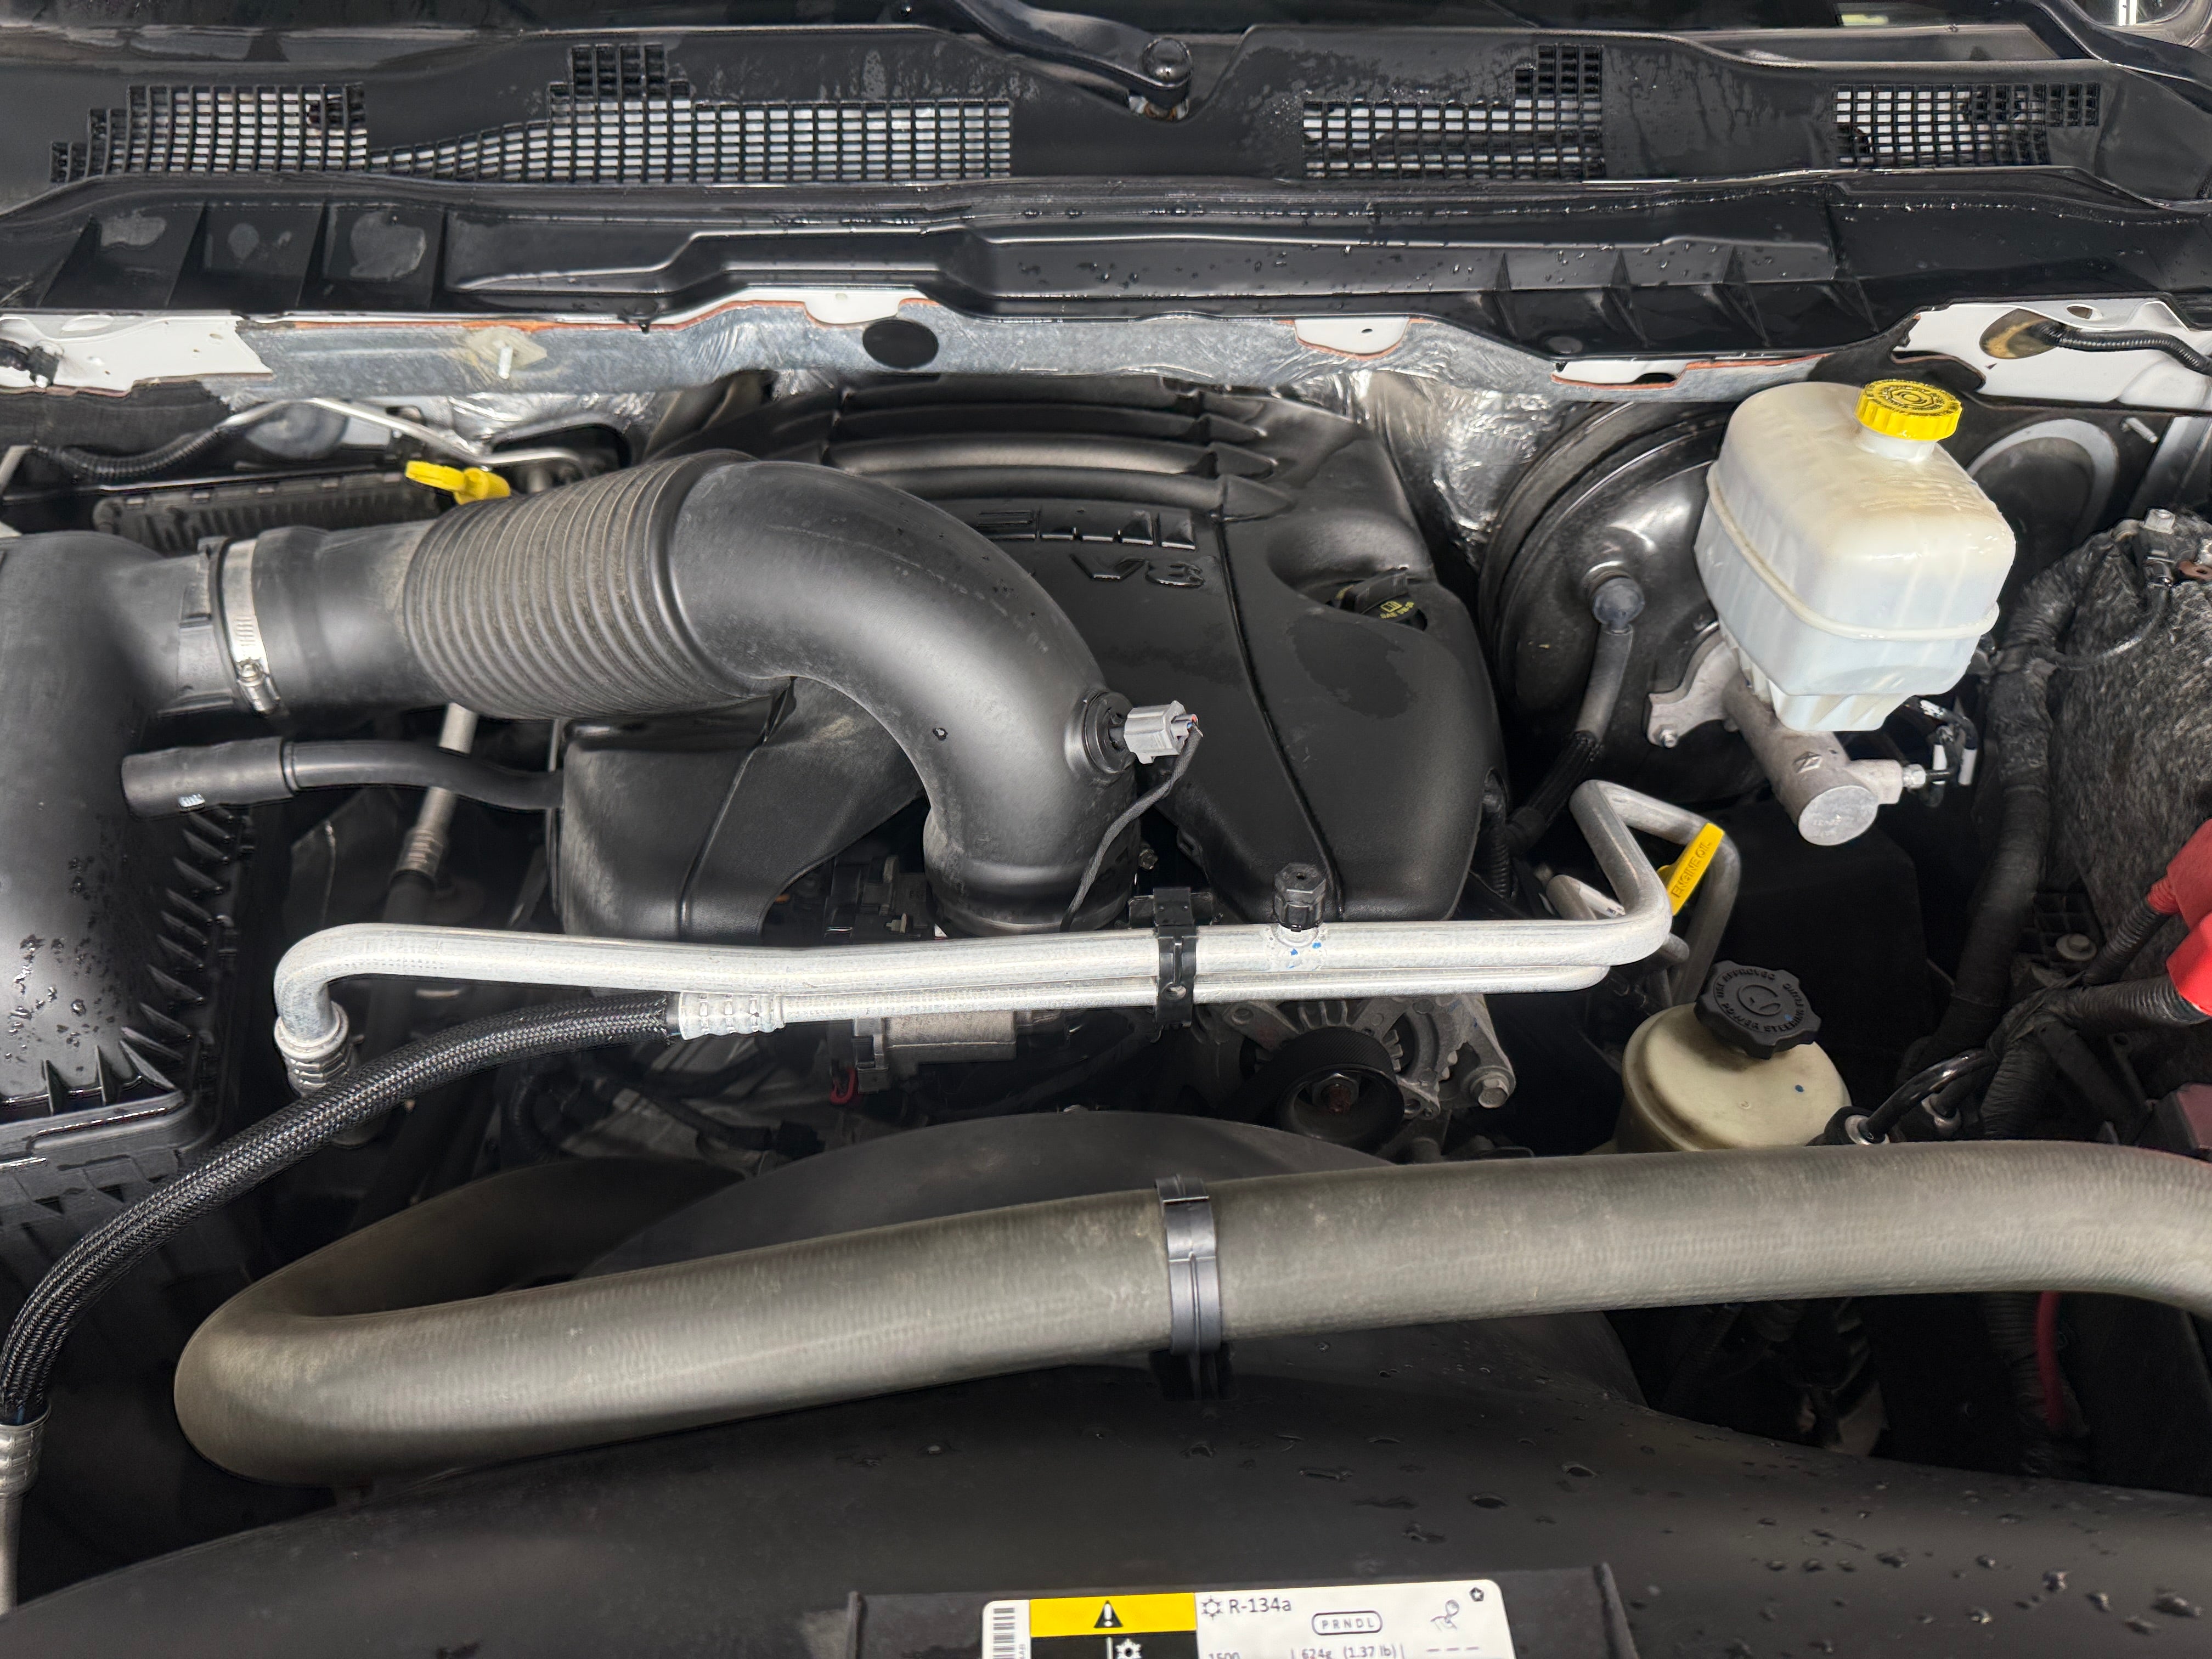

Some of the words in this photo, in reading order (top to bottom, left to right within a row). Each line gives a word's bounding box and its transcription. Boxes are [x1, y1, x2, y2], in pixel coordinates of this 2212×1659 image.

[977, 508, 1196, 550] EMI
[1070, 553, 1205, 588] V8
[1671, 856, 1701, 898] ENGINE
[1695, 842, 1711, 859] OIL
[1722, 968, 1776, 983] APPROVED
[1722, 1002, 1760, 1030] POWER
[1763, 1009, 1805, 1032] STEERING
[1228, 1596, 1292, 1614] R-134a
[1344, 1645, 1375, 1659] (1.37
